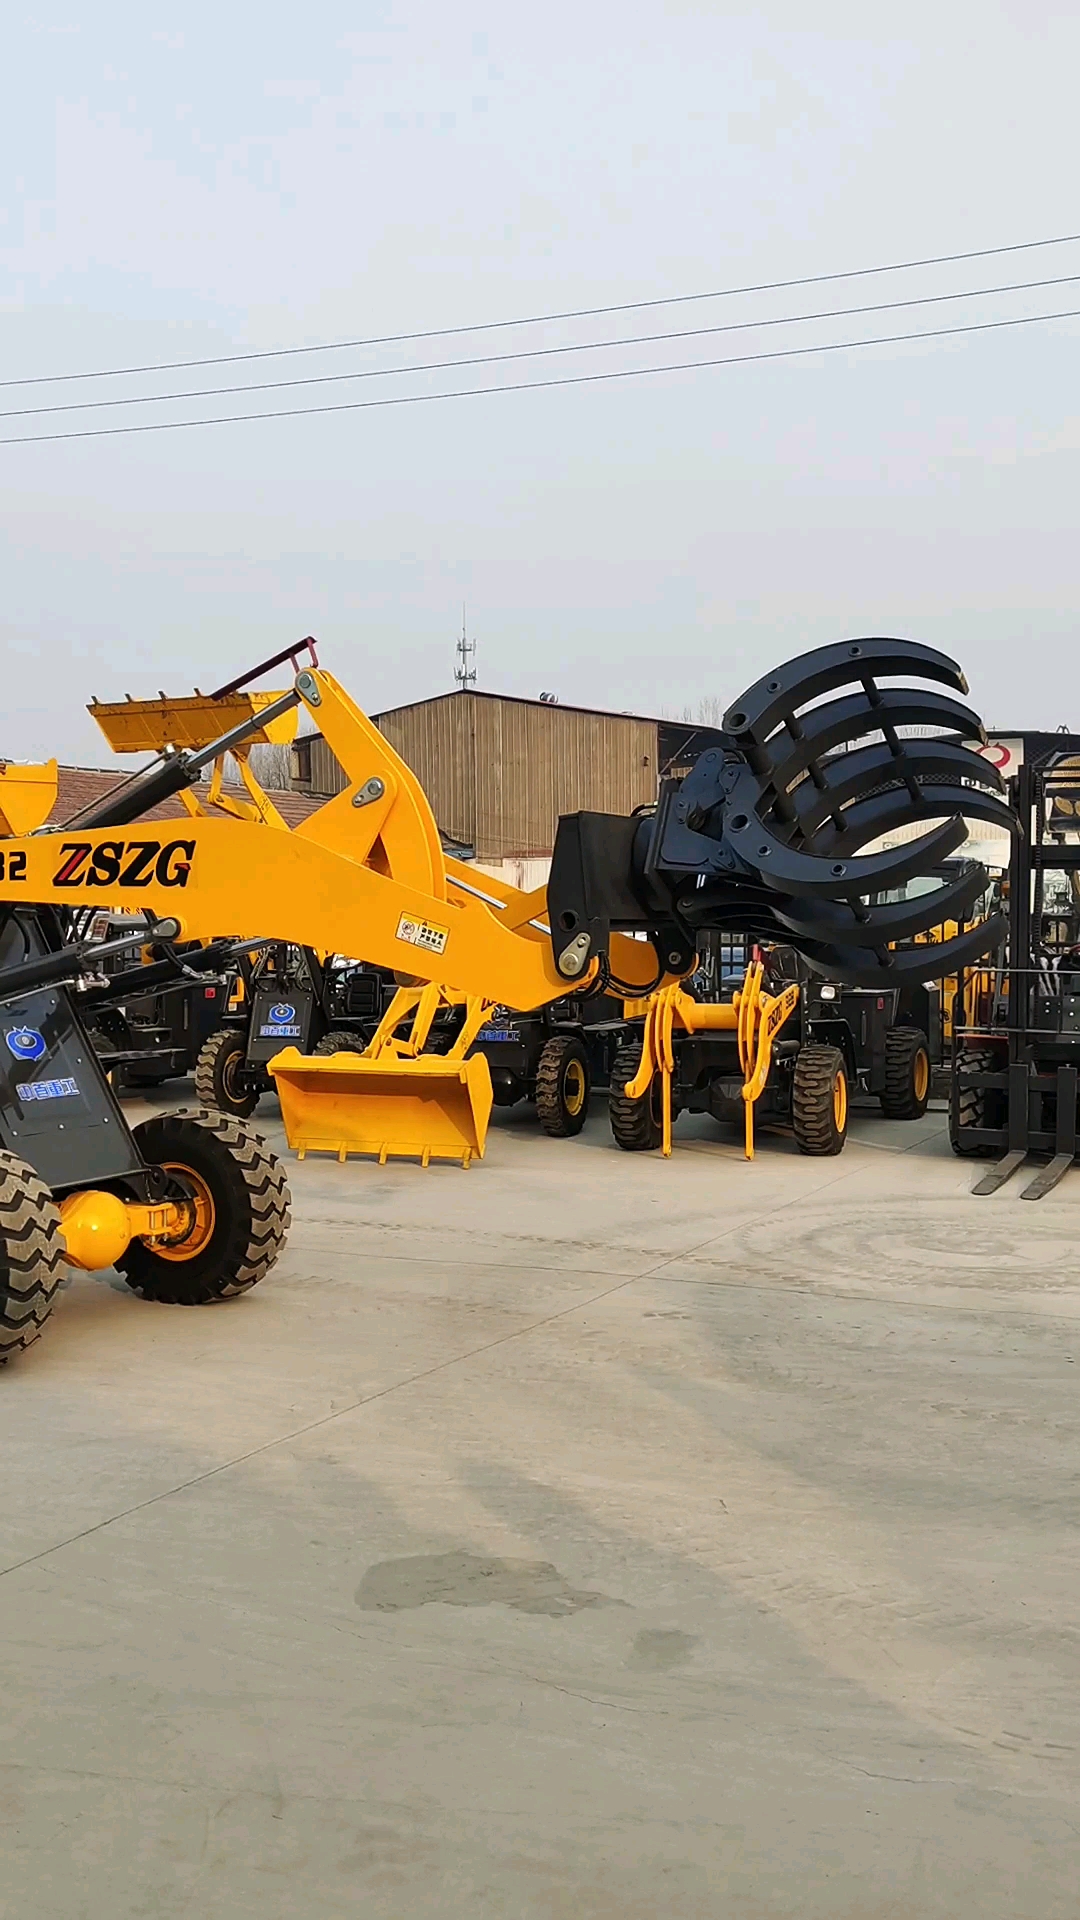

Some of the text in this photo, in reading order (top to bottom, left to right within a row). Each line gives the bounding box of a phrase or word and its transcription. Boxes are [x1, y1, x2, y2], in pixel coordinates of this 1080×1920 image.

[53, 841, 196, 887] ZSZG
[16, 1078, 80, 1101] 中首重工
